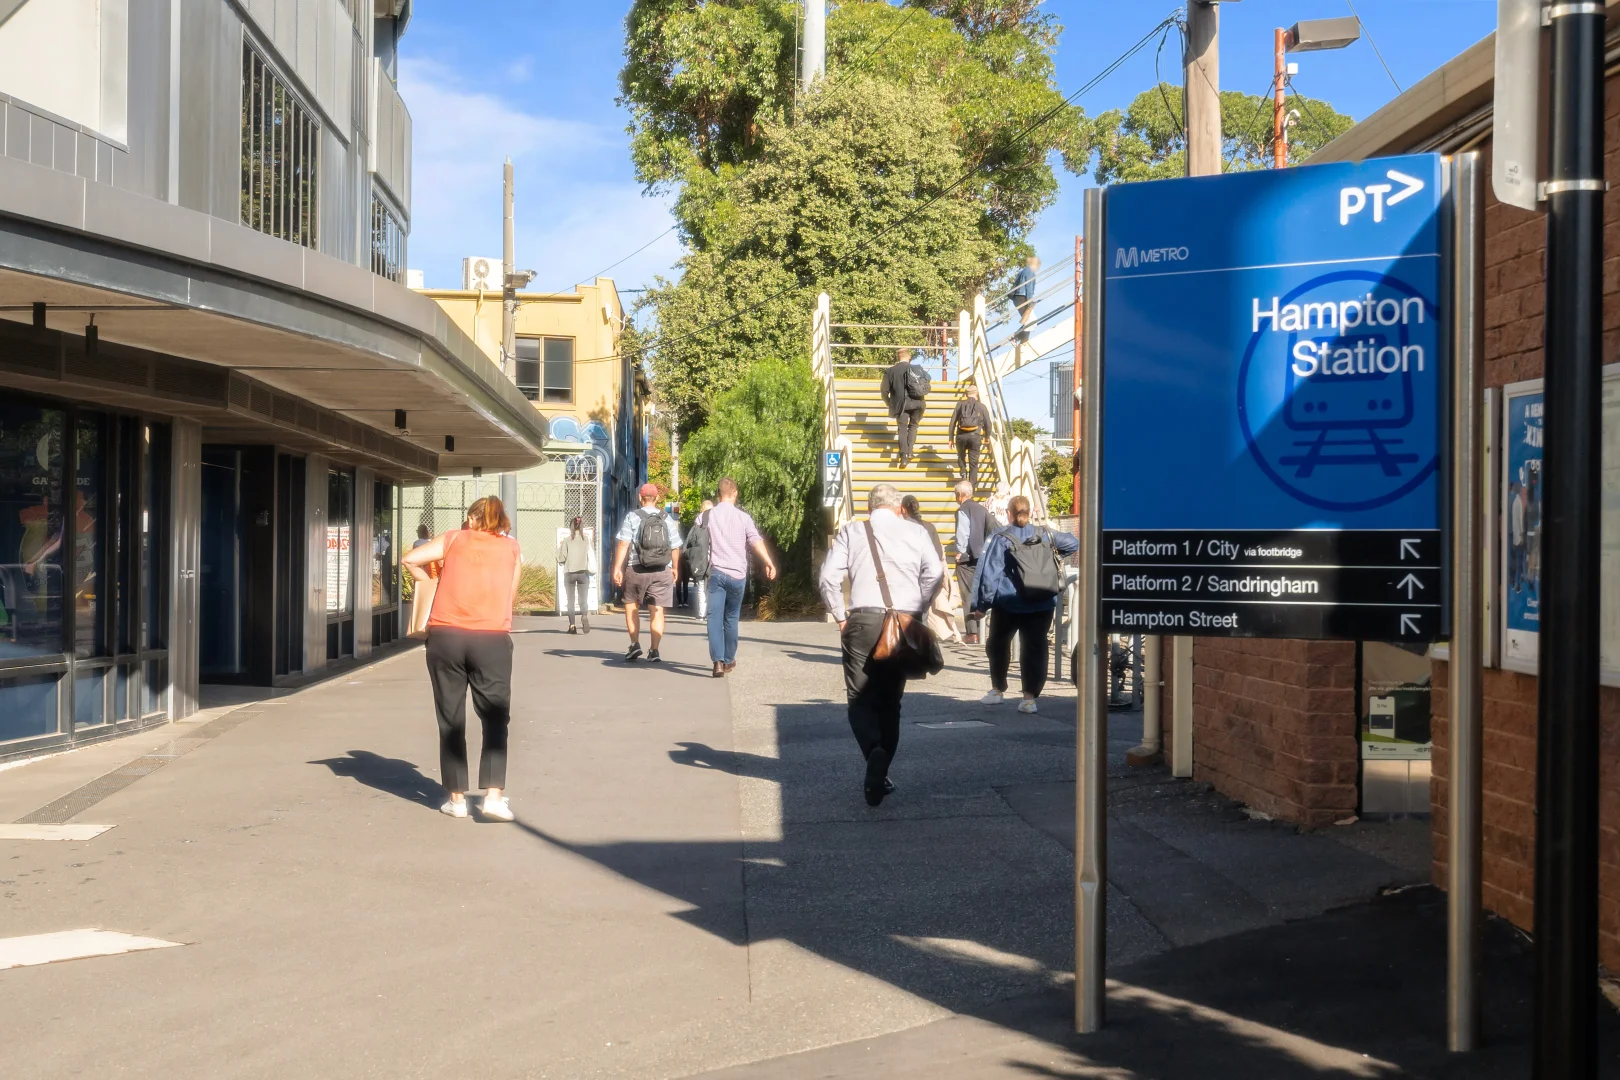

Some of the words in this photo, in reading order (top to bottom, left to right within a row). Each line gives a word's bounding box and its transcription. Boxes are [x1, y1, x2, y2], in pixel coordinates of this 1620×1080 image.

[1140, 246, 1189, 263] METRO
[1252, 292, 1425, 337] Hampton
[1291, 338, 1425, 377] Station
[1112, 539, 1177, 556] Platform
[1183, 540, 1190, 556] 1
[1196, 540, 1204, 556] /
[1207, 540, 1240, 560] City
[1244, 547, 1257, 557] via
[1258, 547, 1303, 559] footbridge
[1112, 574, 1177, 591] Platform
[1182, 575, 1192, 591] 2
[1196, 575, 1204, 591] /
[1207, 575, 1319, 597] Sandringham
[1111, 609, 1184, 629] Hampton
[1189, 610, 1238, 628] Street
